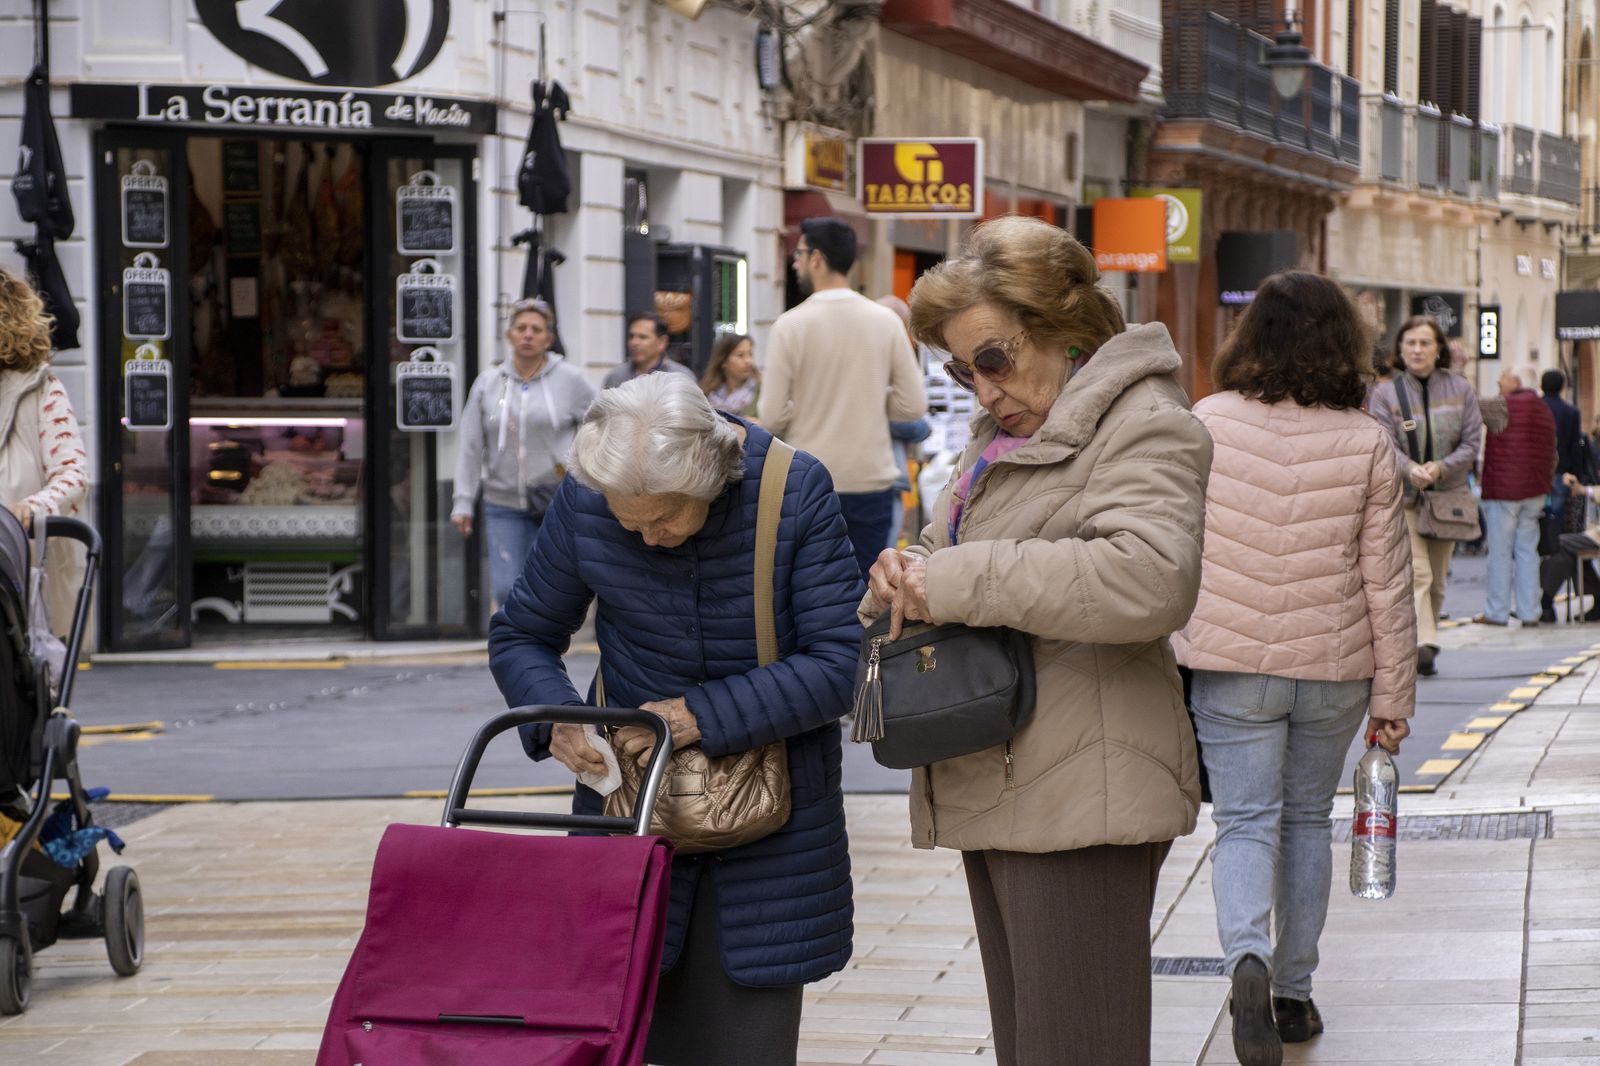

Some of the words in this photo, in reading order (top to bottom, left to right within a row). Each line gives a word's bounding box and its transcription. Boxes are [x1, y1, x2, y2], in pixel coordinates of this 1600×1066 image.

[136, 83, 190, 121] La
[202, 84, 372, 128] Serranía
[384, 95, 414, 121] de
[124, 177, 164, 188] OFERTA
[399, 186, 452, 197] OFERTA
[866, 183, 972, 205] TABACOS
[1097, 253, 1159, 271] orange
[125, 269, 165, 281] OFERTA
[399, 276, 452, 286] OFERTA
[126, 360, 167, 371] OFERTA
[398, 364, 452, 374] OFERTA
